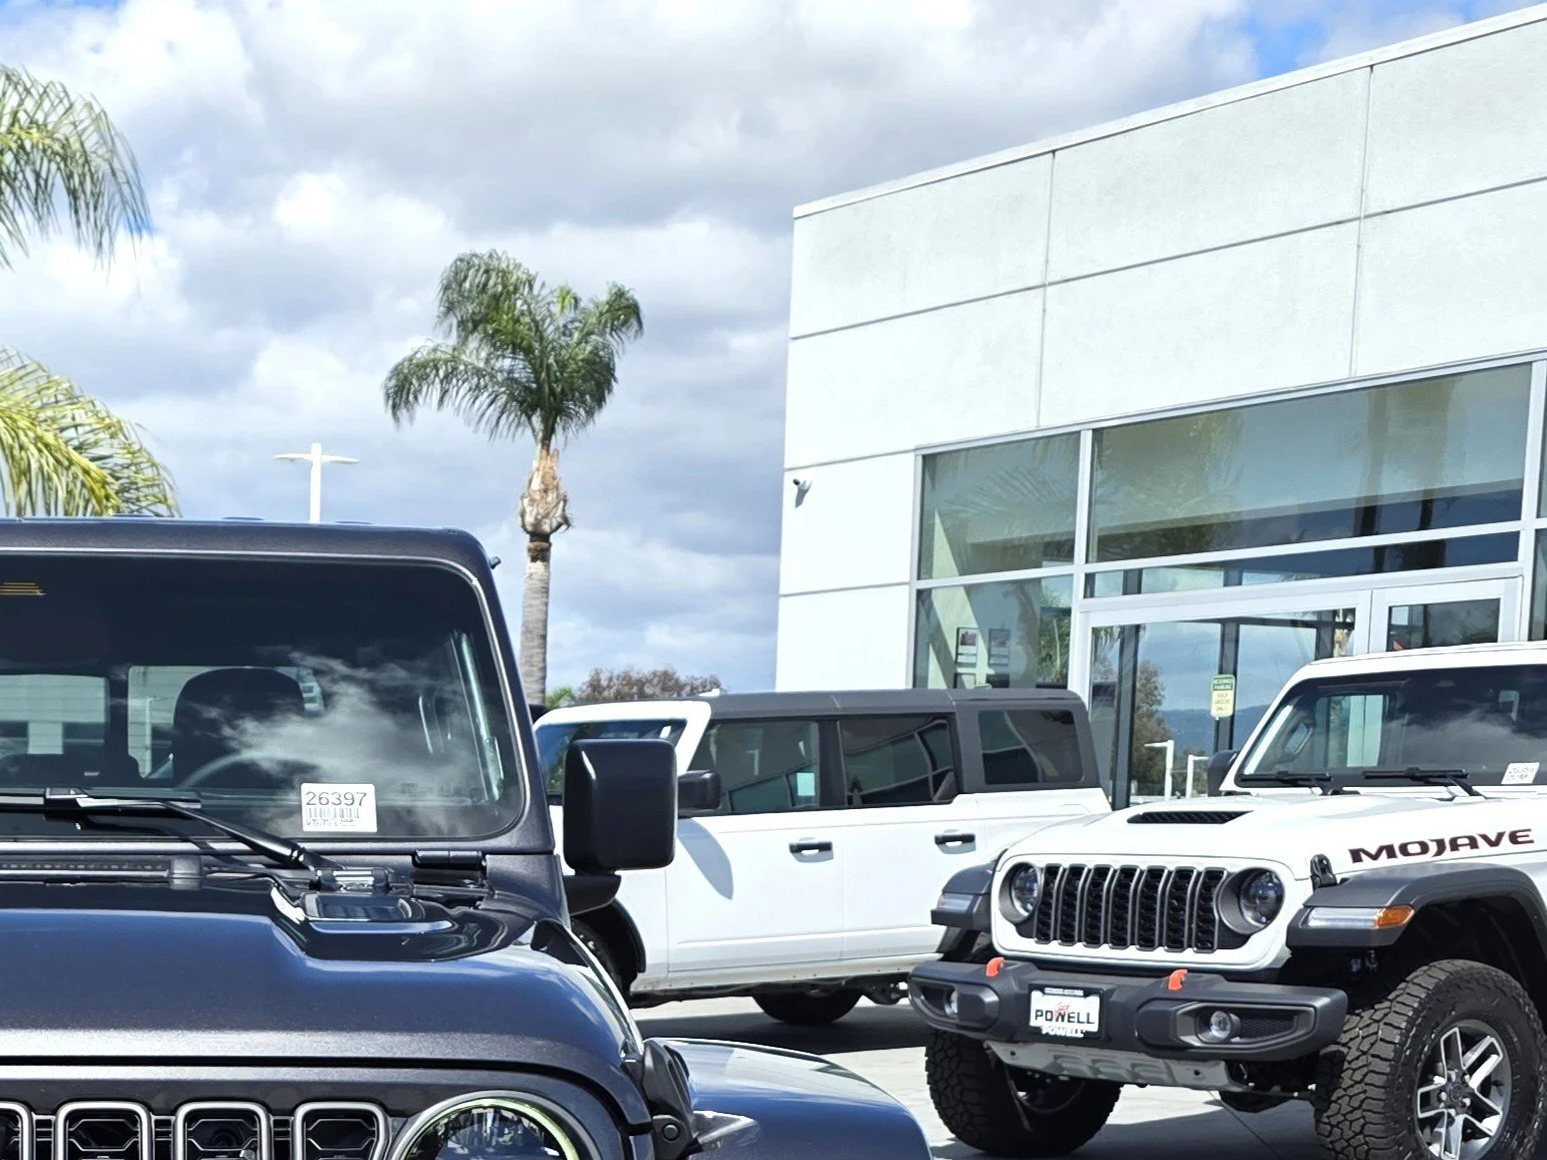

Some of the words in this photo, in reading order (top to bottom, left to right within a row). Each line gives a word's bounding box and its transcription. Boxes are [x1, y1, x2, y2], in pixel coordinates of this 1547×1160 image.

[305, 791, 367, 806] 26397
[1348, 828, 1535, 864] MOJAVE
[1034, 1009, 1095, 1025] POWELL
